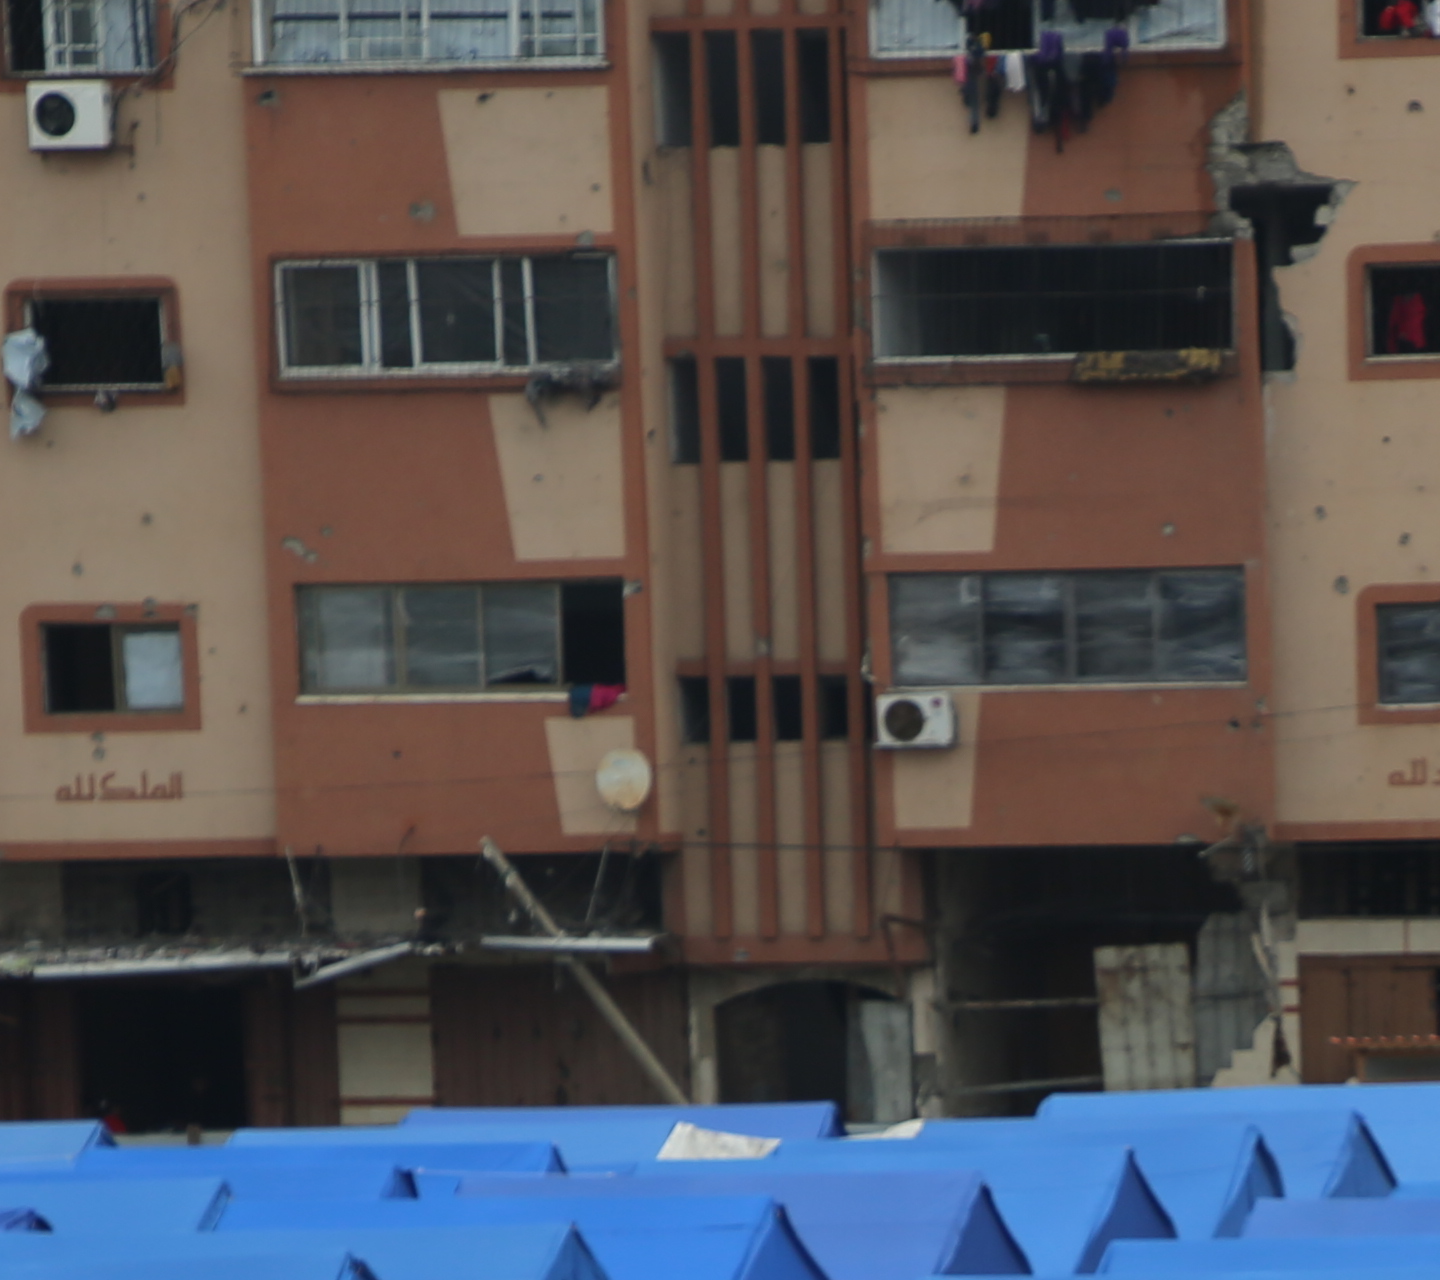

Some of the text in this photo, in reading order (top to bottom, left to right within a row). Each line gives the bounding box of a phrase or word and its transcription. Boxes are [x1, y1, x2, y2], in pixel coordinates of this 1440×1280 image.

[55, 769, 184, 802] الملك لله
[1389, 758, 1427, 786] لله
